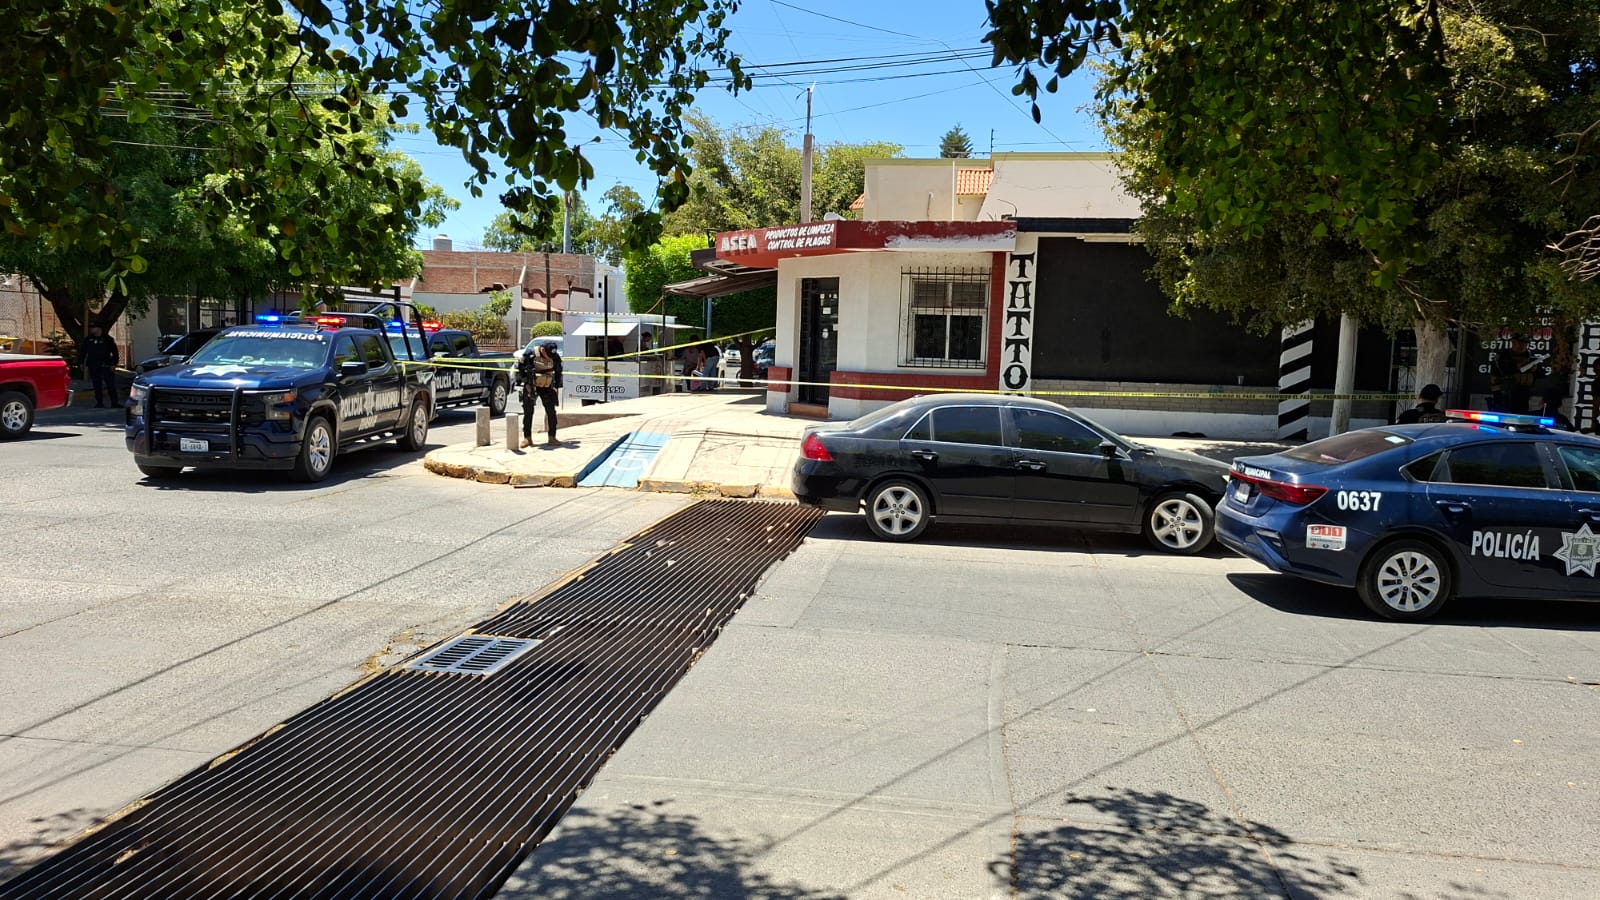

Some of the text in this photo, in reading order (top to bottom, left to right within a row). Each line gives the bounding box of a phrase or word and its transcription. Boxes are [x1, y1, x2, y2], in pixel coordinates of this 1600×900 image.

[765, 223, 835, 240] PRODUCTOS DE LIMPIEZA
[721, 234, 757, 251] ASEA
[767, 235, 831, 250] CONTROL DE PLAGAS
[1245, 467, 1271, 480] MUNICIPAL
[1337, 491, 1382, 511] 0637
[1311, 526, 1342, 537] 911
[1471, 529, 1540, 560] POLICÍA
